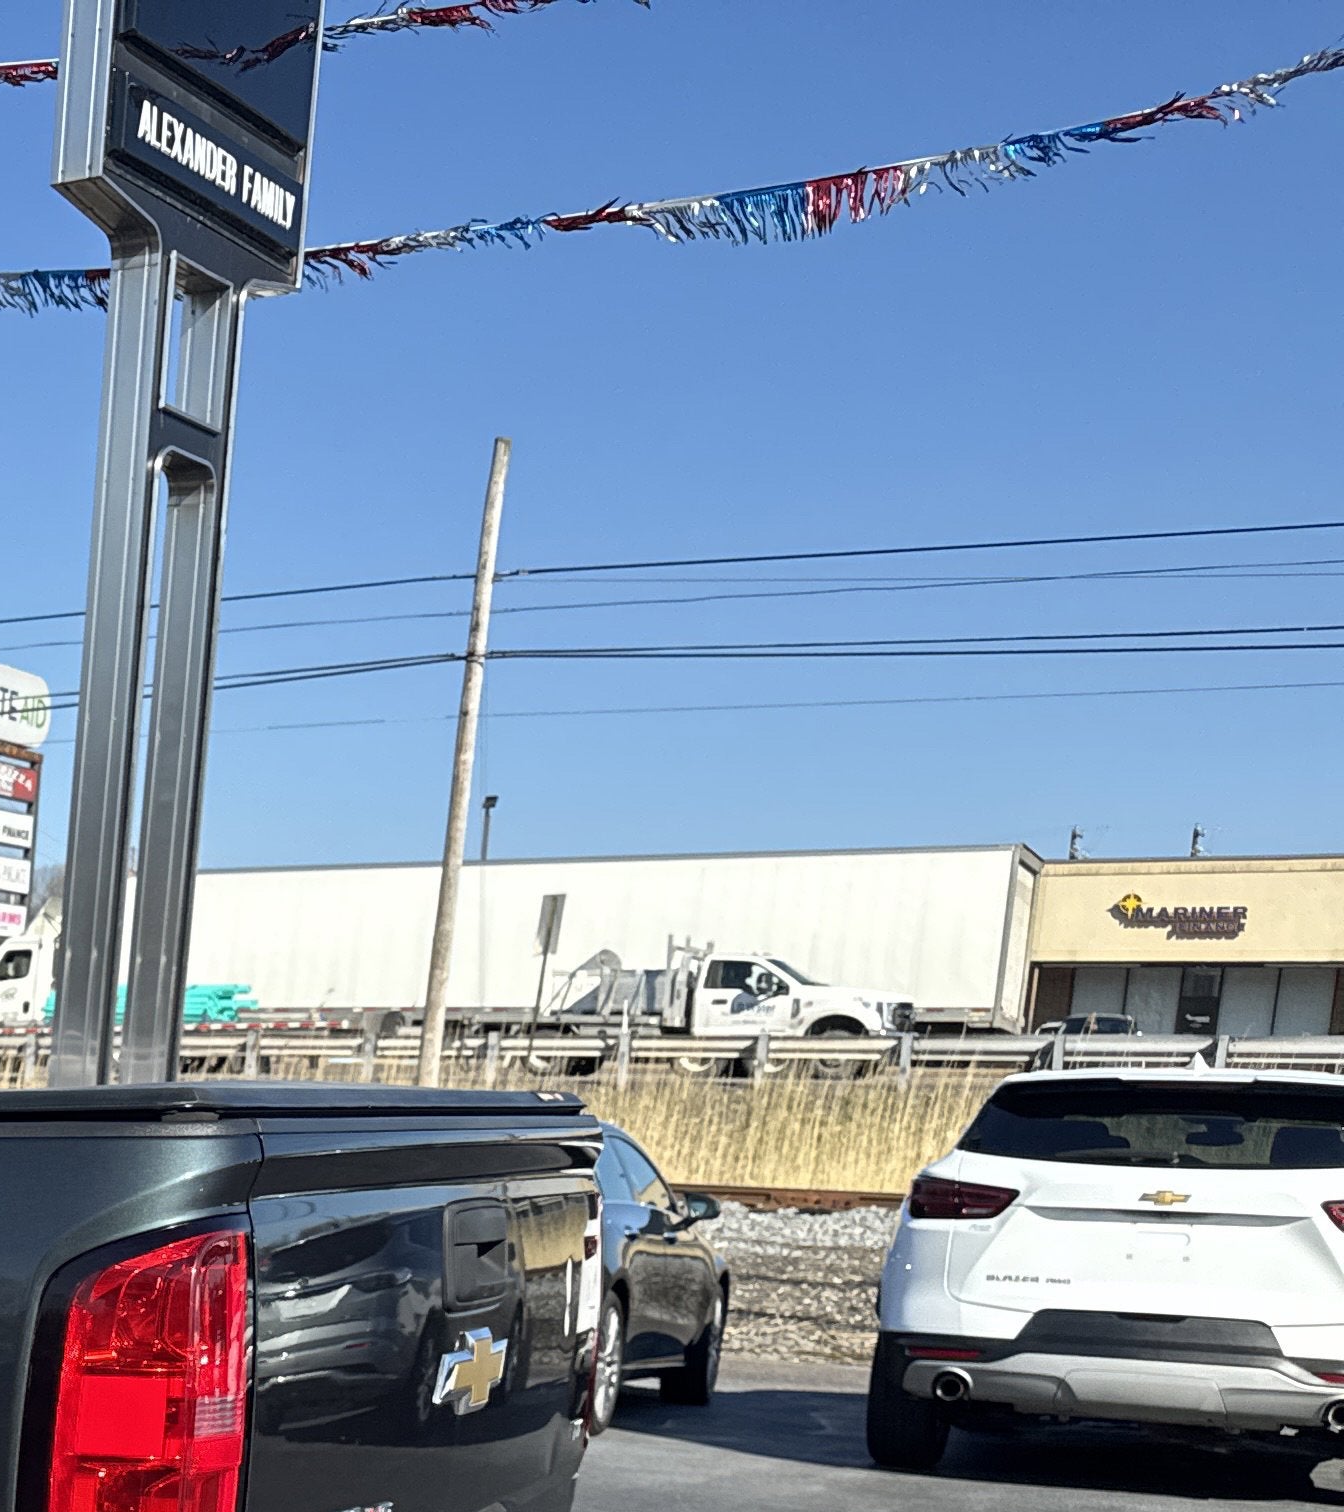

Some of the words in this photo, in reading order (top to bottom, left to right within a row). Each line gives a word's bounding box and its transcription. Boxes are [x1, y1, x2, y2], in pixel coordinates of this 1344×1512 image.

[136, 99, 237, 197] ALEXANDER
[242, 164, 296, 230] FAMILY
[19, 698, 48, 729] AID
[1132, 905, 1249, 922] MARINER
